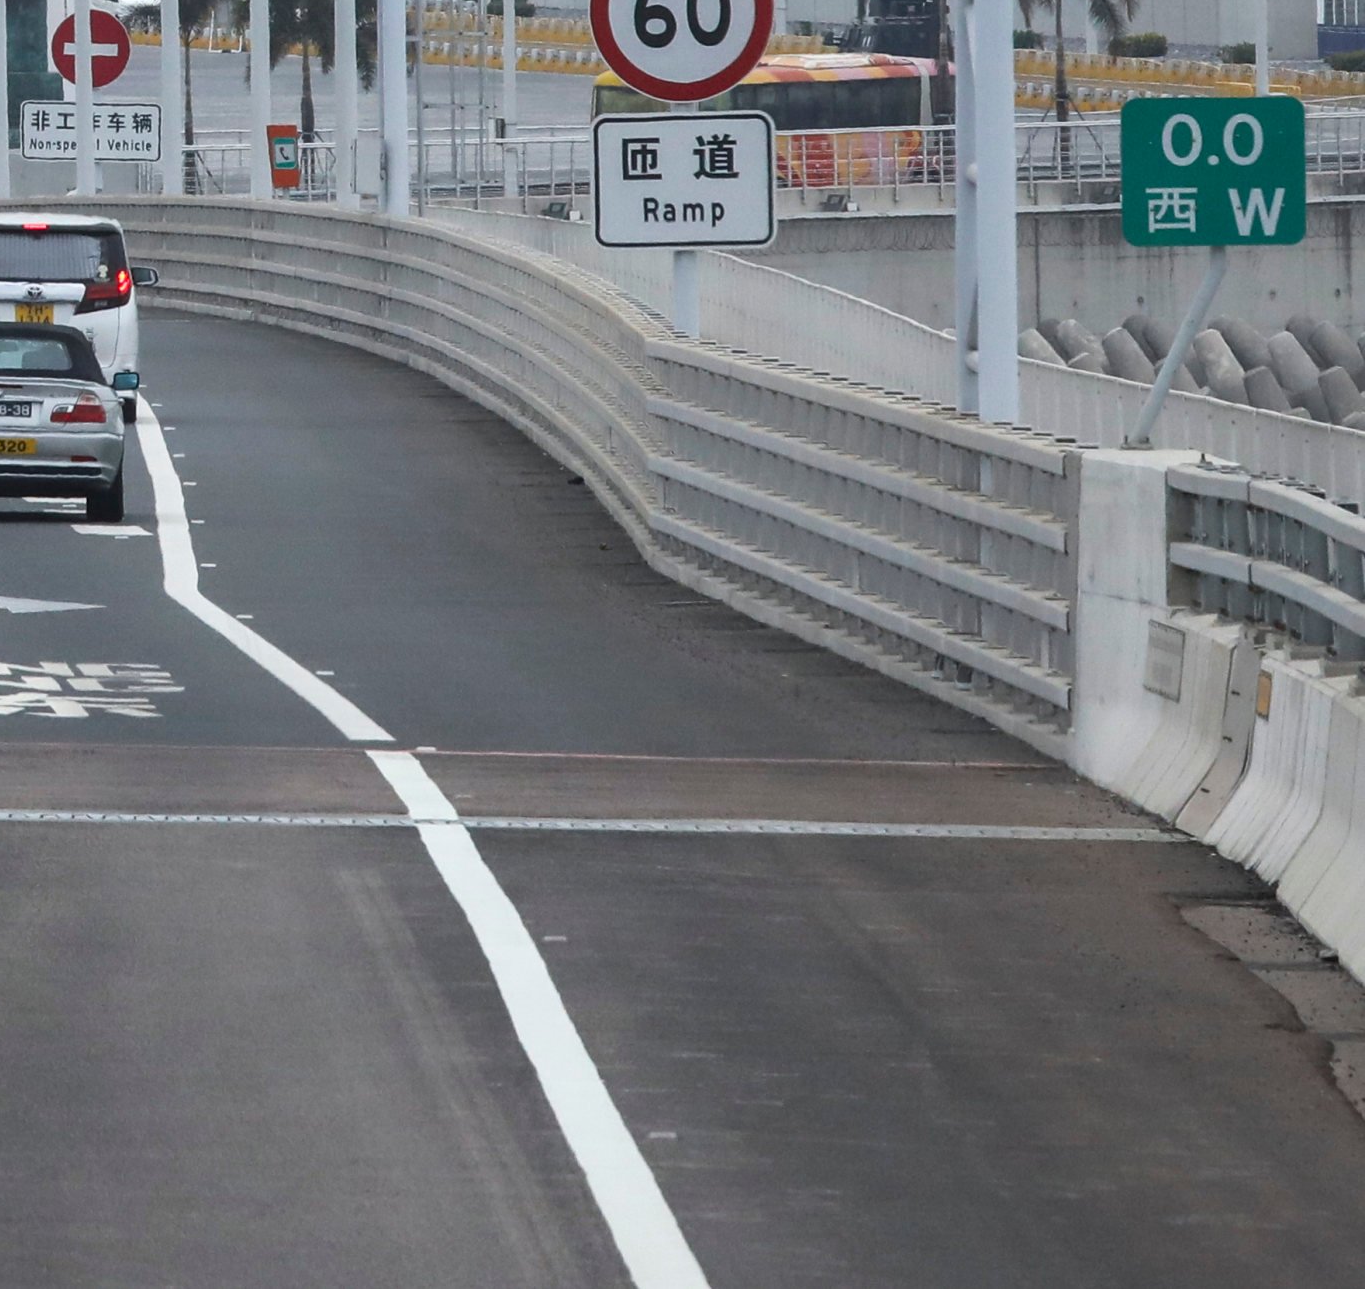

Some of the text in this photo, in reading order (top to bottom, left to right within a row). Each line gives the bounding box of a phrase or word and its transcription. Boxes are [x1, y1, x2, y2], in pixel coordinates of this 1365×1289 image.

[107, 139, 152, 151] Vehicle
[621, 134, 740, 181] 匝道
[1160, 113, 1265, 168] 0.0
[642, 196, 726, 228] Ramp
[1146, 187, 1286, 238] 西 W
